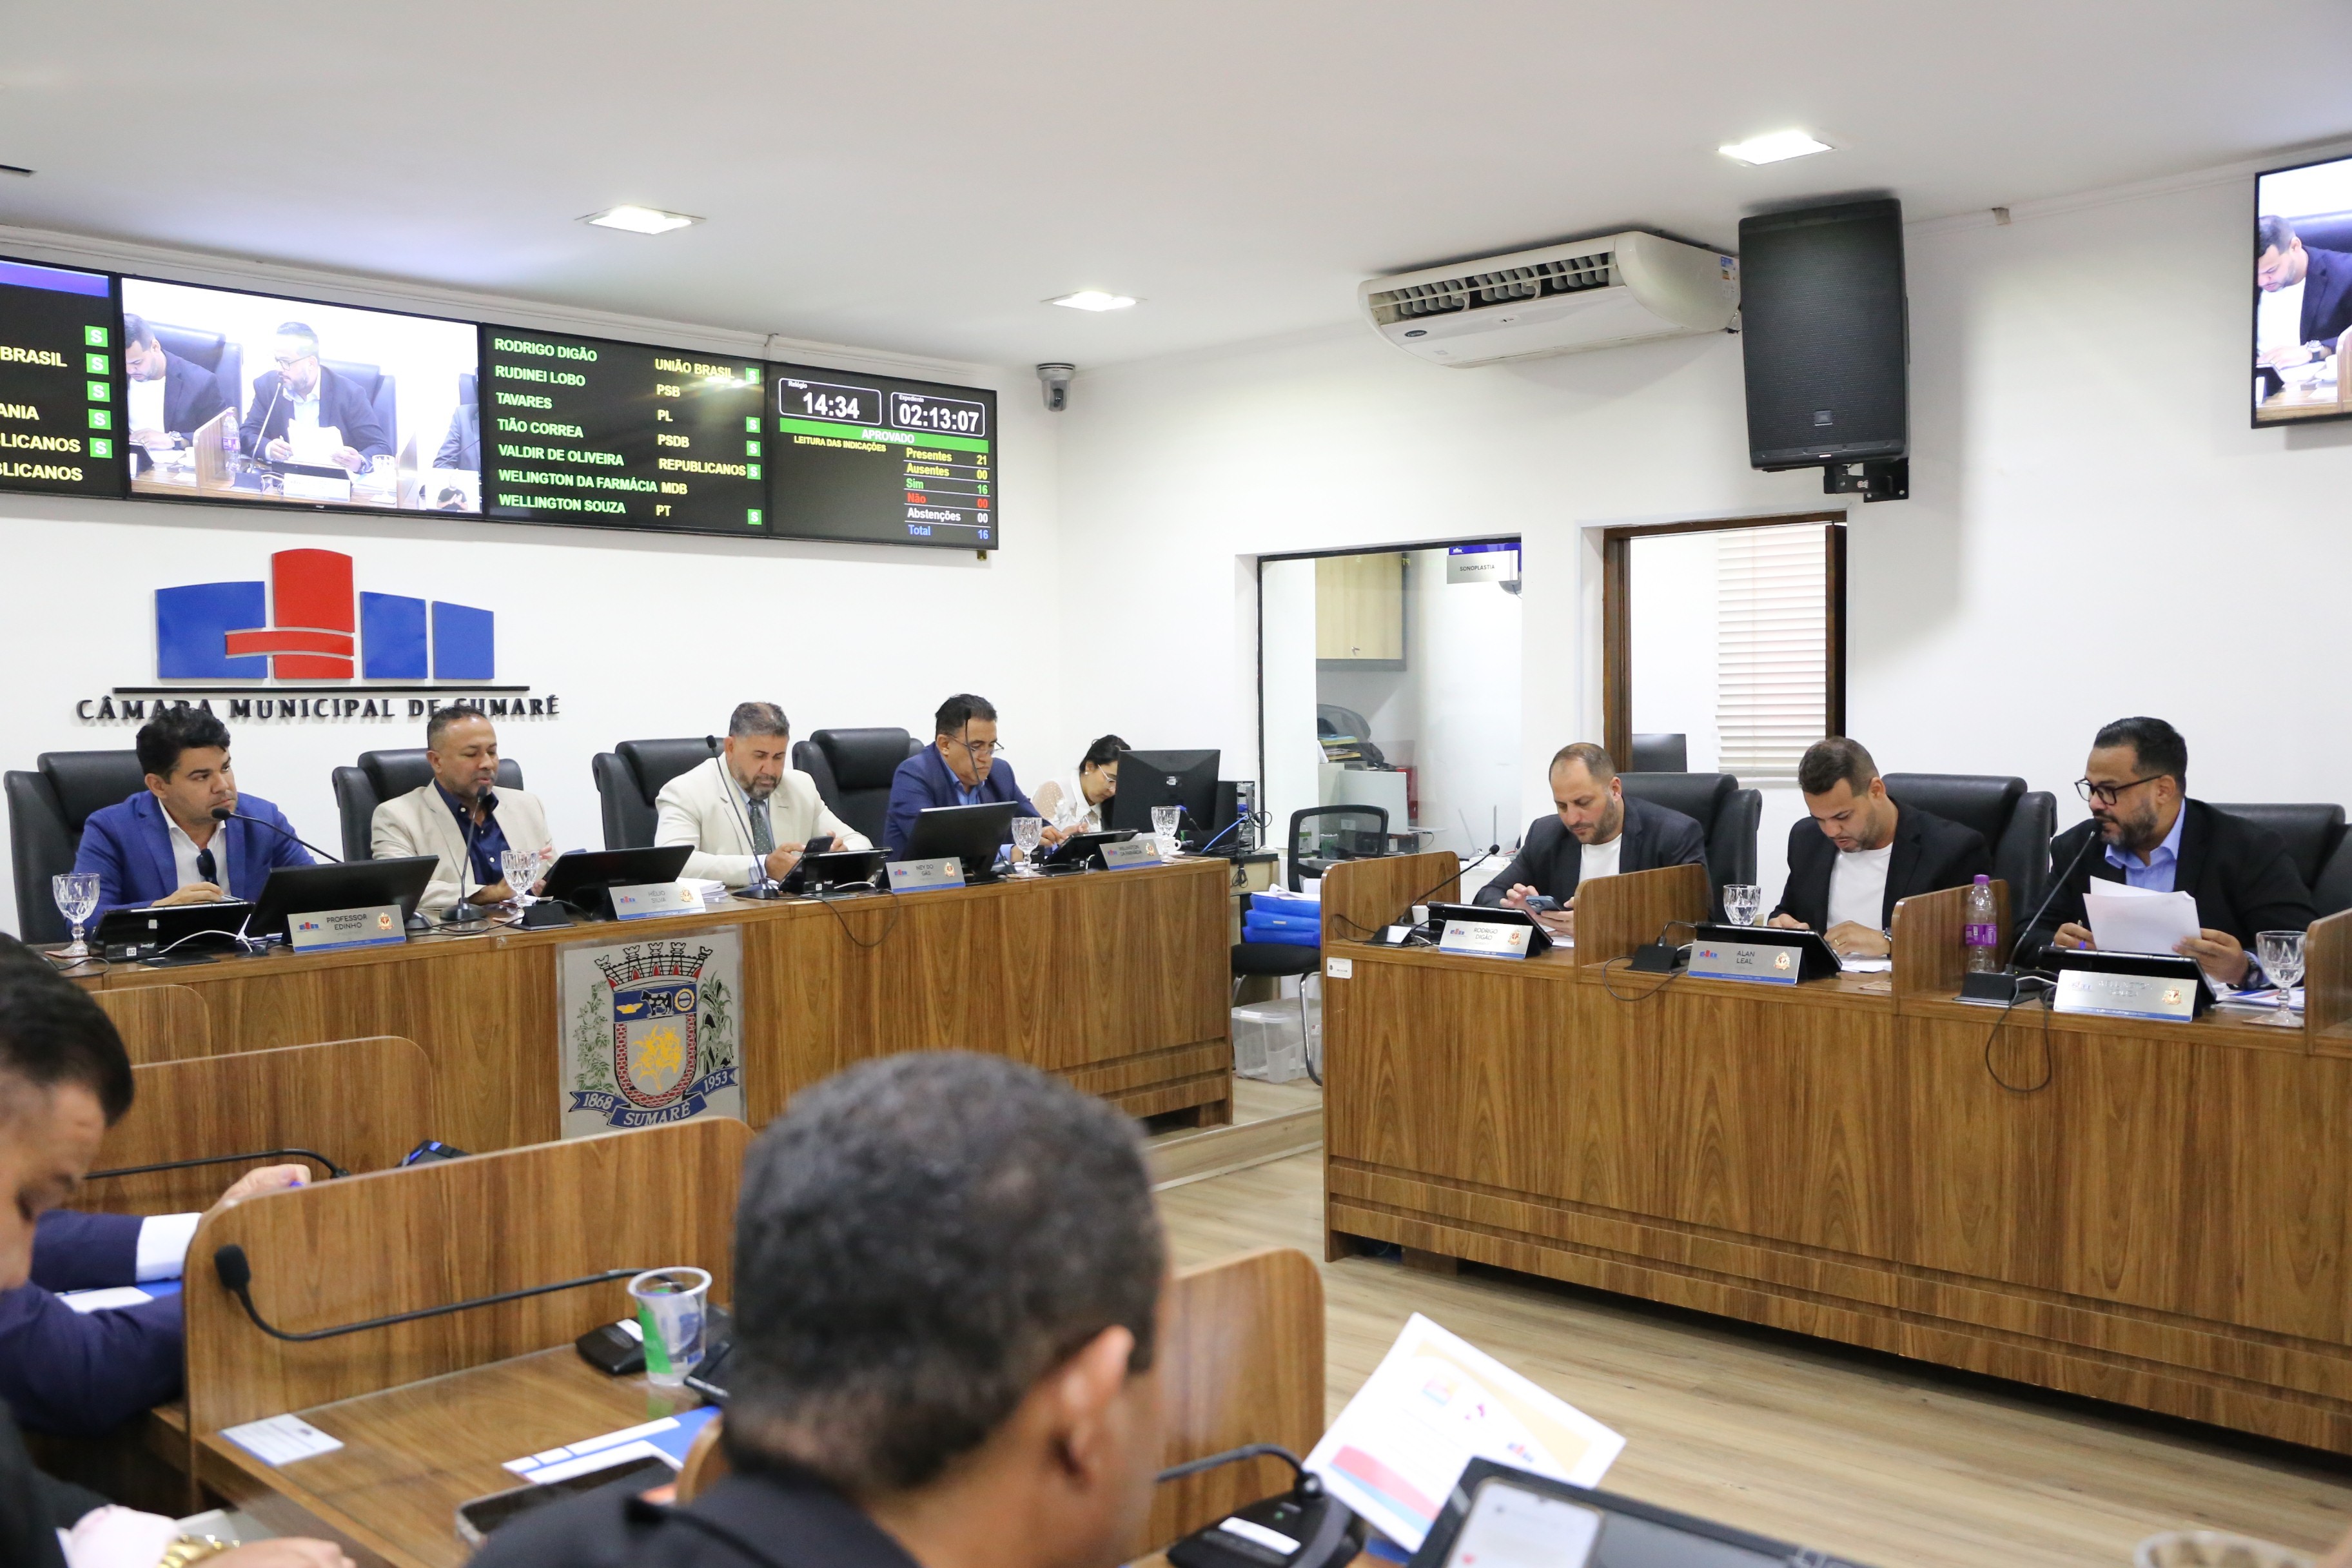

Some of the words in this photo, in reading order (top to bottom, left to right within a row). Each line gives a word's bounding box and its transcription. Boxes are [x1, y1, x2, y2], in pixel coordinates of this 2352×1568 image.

[90, 329, 103, 344] S
[0, 346, 68, 368] BRASIL
[495, 338, 555, 357] RODRIGO
[557, 346, 598, 362] DIGÃO
[92, 357, 104, 371] S
[655, 358, 692, 373] UNIÃO
[694, 363, 735, 379] BRASIL
[495, 365, 547, 382] RUDINEI
[550, 371, 586, 386] LOBO
[749, 370, 756, 381] S
[92, 384, 104, 398] S
[656, 384, 681, 398] PSB
[788, 380, 808, 389] Relógio
[496, 392, 553, 409] TAVARES
[803, 392, 860, 419] 14:34
[899, 395, 925, 404] Expediente
[93, 412, 106, 426] S
[657, 409, 673, 422] PL
[899, 403, 979, 432] 02:13:07
[497, 417, 527, 433] TIÃO
[530, 422, 584, 438] CORREA
[749, 420, 757, 430] S
[0, 433, 81, 453] LICANOS
[658, 433, 690, 448] PSDB
[794, 435, 826, 446] LEITURA
[827, 438, 842, 449] DAS
[843, 440, 887, 453] INDICAÇÕES
[861, 428, 915, 444] APROVADO
[95, 441, 107, 455] S
[498, 444, 545, 460] VALDIR
[547, 448, 565, 462] DE
[567, 451, 625, 466] OLIVEIRA
[750, 443, 758, 454] S
[906, 447, 952, 462] Presentes
[977, 455, 987, 466] 21
[0, 462, 83, 482] LICANOS
[658, 458, 747, 476] REPUBLICANOS
[750, 466, 758, 477] S
[906, 463, 950, 476] Ausentes
[977, 469, 988, 480] 00
[498, 469, 574, 487] WELINGTON
[576, 475, 594, 488] DA
[596, 477, 658, 493] FARMÁCIA
[661, 482, 688, 495] MDB
[906, 478, 924, 489] Sim
[977, 484, 988, 495] 16
[498, 494, 582, 511] WELLINGTON
[584, 500, 626, 514] SOUZA
[907, 493, 927, 504] Não
[977, 498, 988, 508] 00
[656, 504, 672, 516] PT
[750, 511, 759, 522] S
[907, 507, 961, 522] Abstenções
[977, 513, 988, 523] 00
[908, 524, 931, 536] Total
[977, 529, 989, 540] 16
[229, 698, 395, 720] MUNICIPAL
[408, 698, 441, 716] DE
[326, 914, 368, 923] PROFESSOR
[335, 922, 362, 930] EDINHO
[703, 1070, 729, 1092] 1953
[583, 1093, 614, 1110] 1868
[623, 1102, 692, 1126] SUMARÉ
